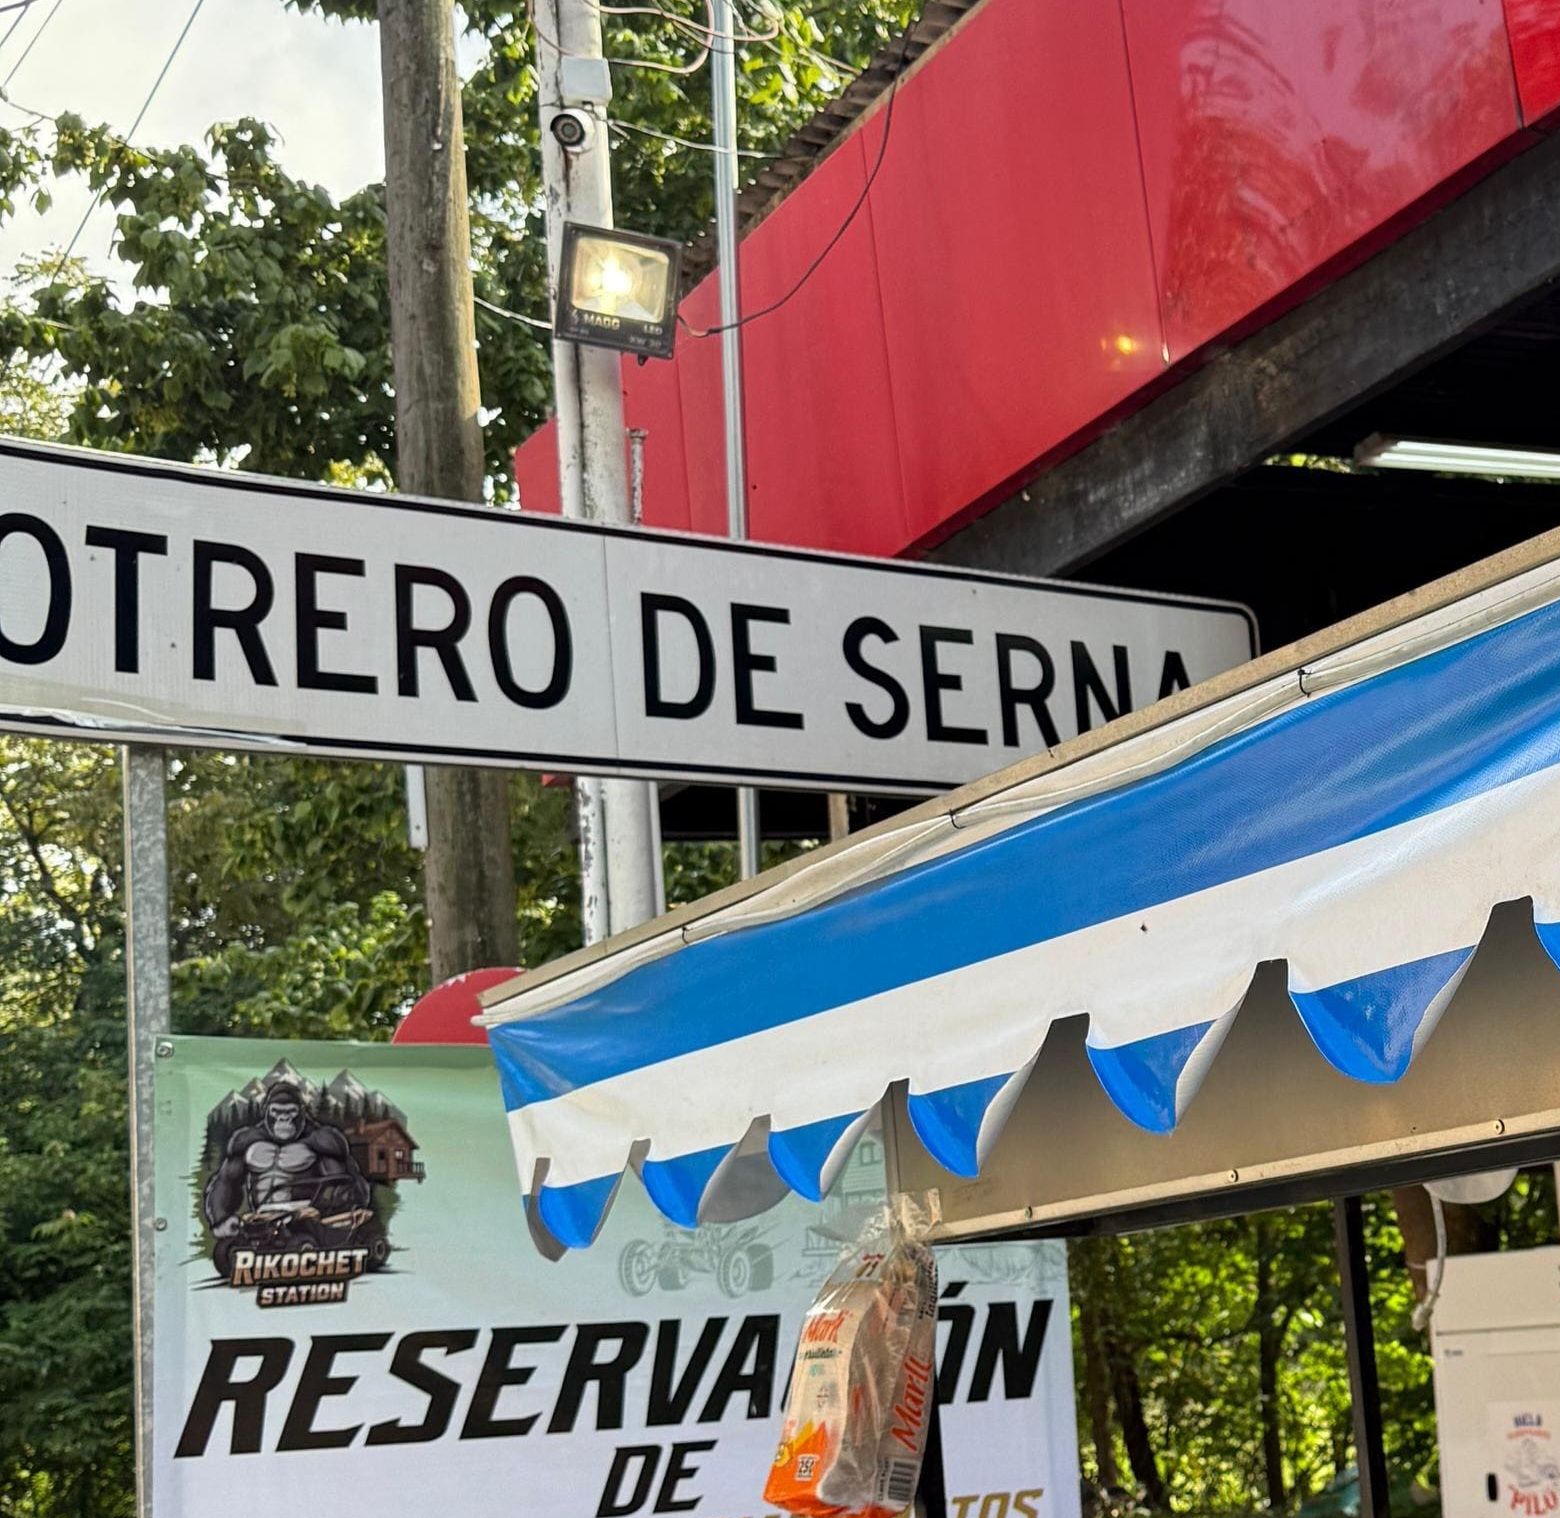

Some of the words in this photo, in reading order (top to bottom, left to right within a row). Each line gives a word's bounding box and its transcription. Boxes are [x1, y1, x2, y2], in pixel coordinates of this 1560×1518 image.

[0, 512, 574, 709] OTRERO
[641, 592, 804, 730] DE
[231, 1249, 369, 1286] RIKOCHET
[260, 1282, 345, 1306] STATION
[174, 1281, 1055, 1460] RESERVAÓN
[597, 1440, 718, 1518] DE
